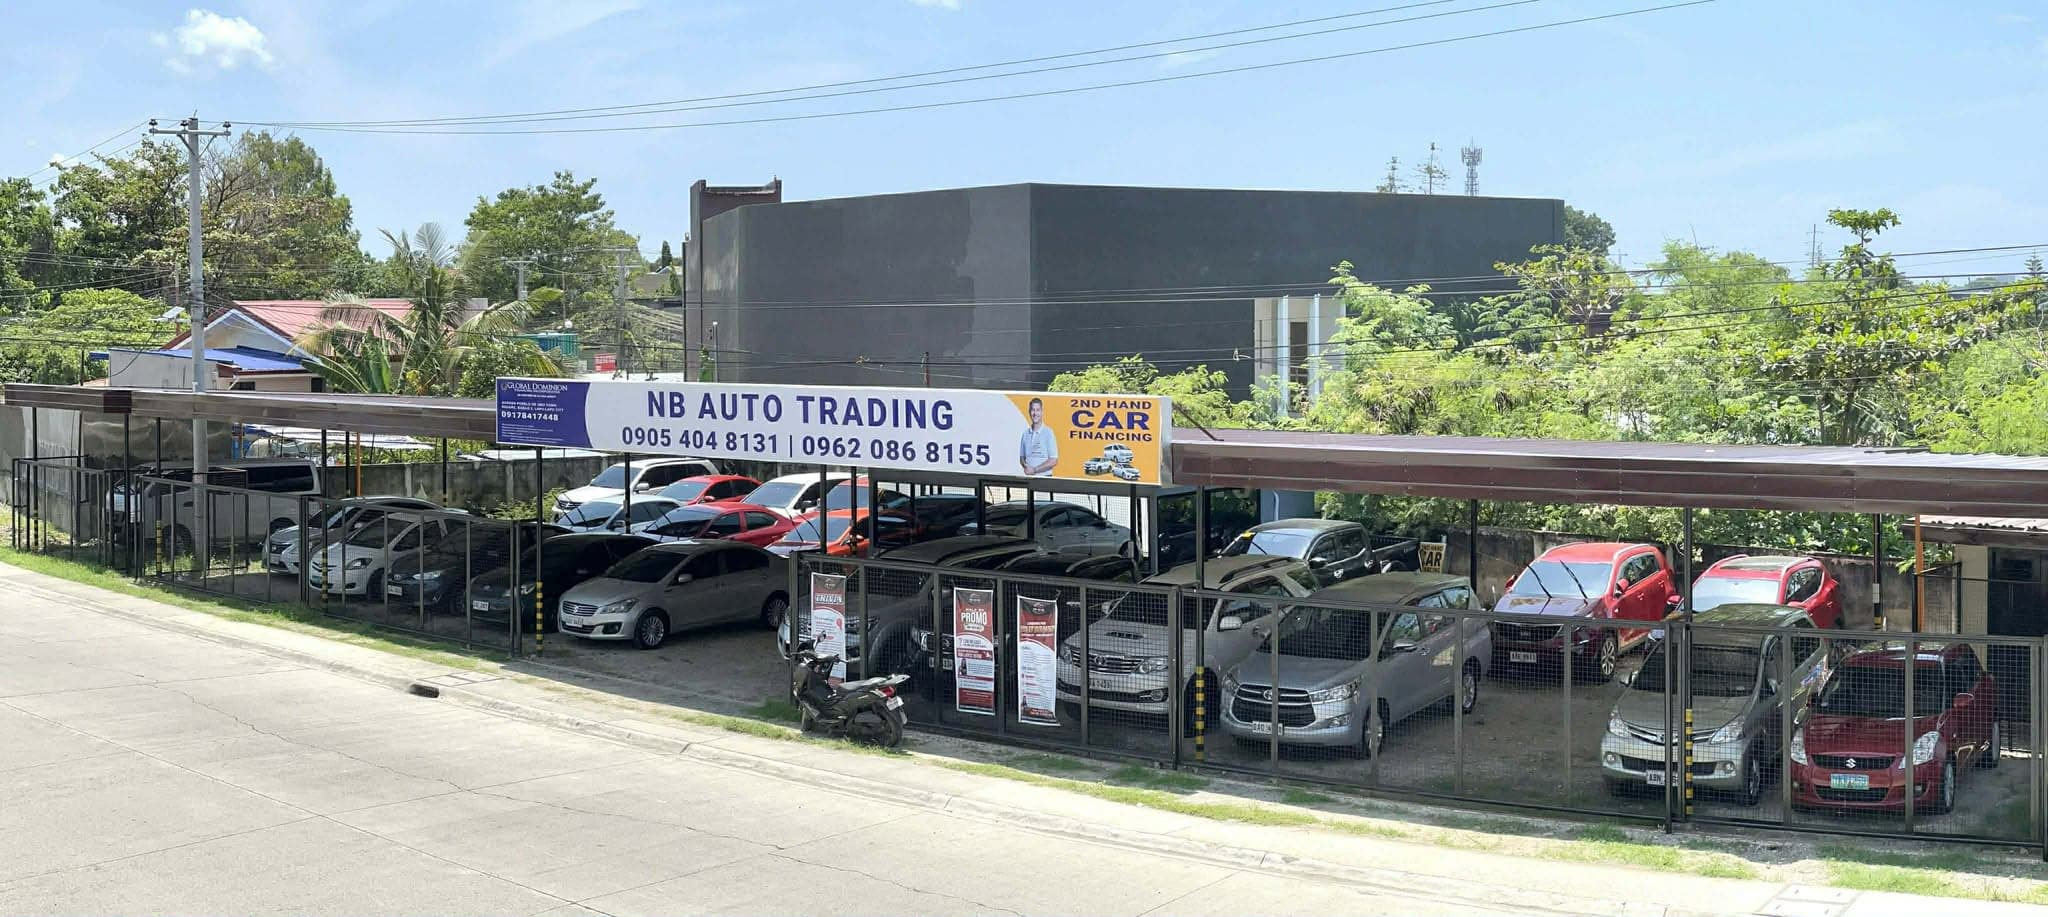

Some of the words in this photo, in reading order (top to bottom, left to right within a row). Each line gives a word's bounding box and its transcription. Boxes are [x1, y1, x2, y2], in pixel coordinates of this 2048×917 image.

[507, 382, 532, 390] GLOBAL
[533, 383, 568, 392] DOMINION
[648, 391, 685, 418] NB
[698, 393, 782, 422] AUTO
[796, 396, 952, 430] TRADING
[1071, 400, 1100, 408] 2ND
[1107, 400, 1151, 409] HAND
[1072, 410, 1149, 430] CAR
[622, 427, 671, 447] 0905
[679, 430, 717, 450] 404
[726, 432, 776, 453] 8131
[1070, 431, 1152, 441] FINANCING
[803, 436, 861, 458] 0962
[871, 439, 916, 461] 086
[926, 442, 990, 465] 8155
[961, 612, 987, 625] PROMO
